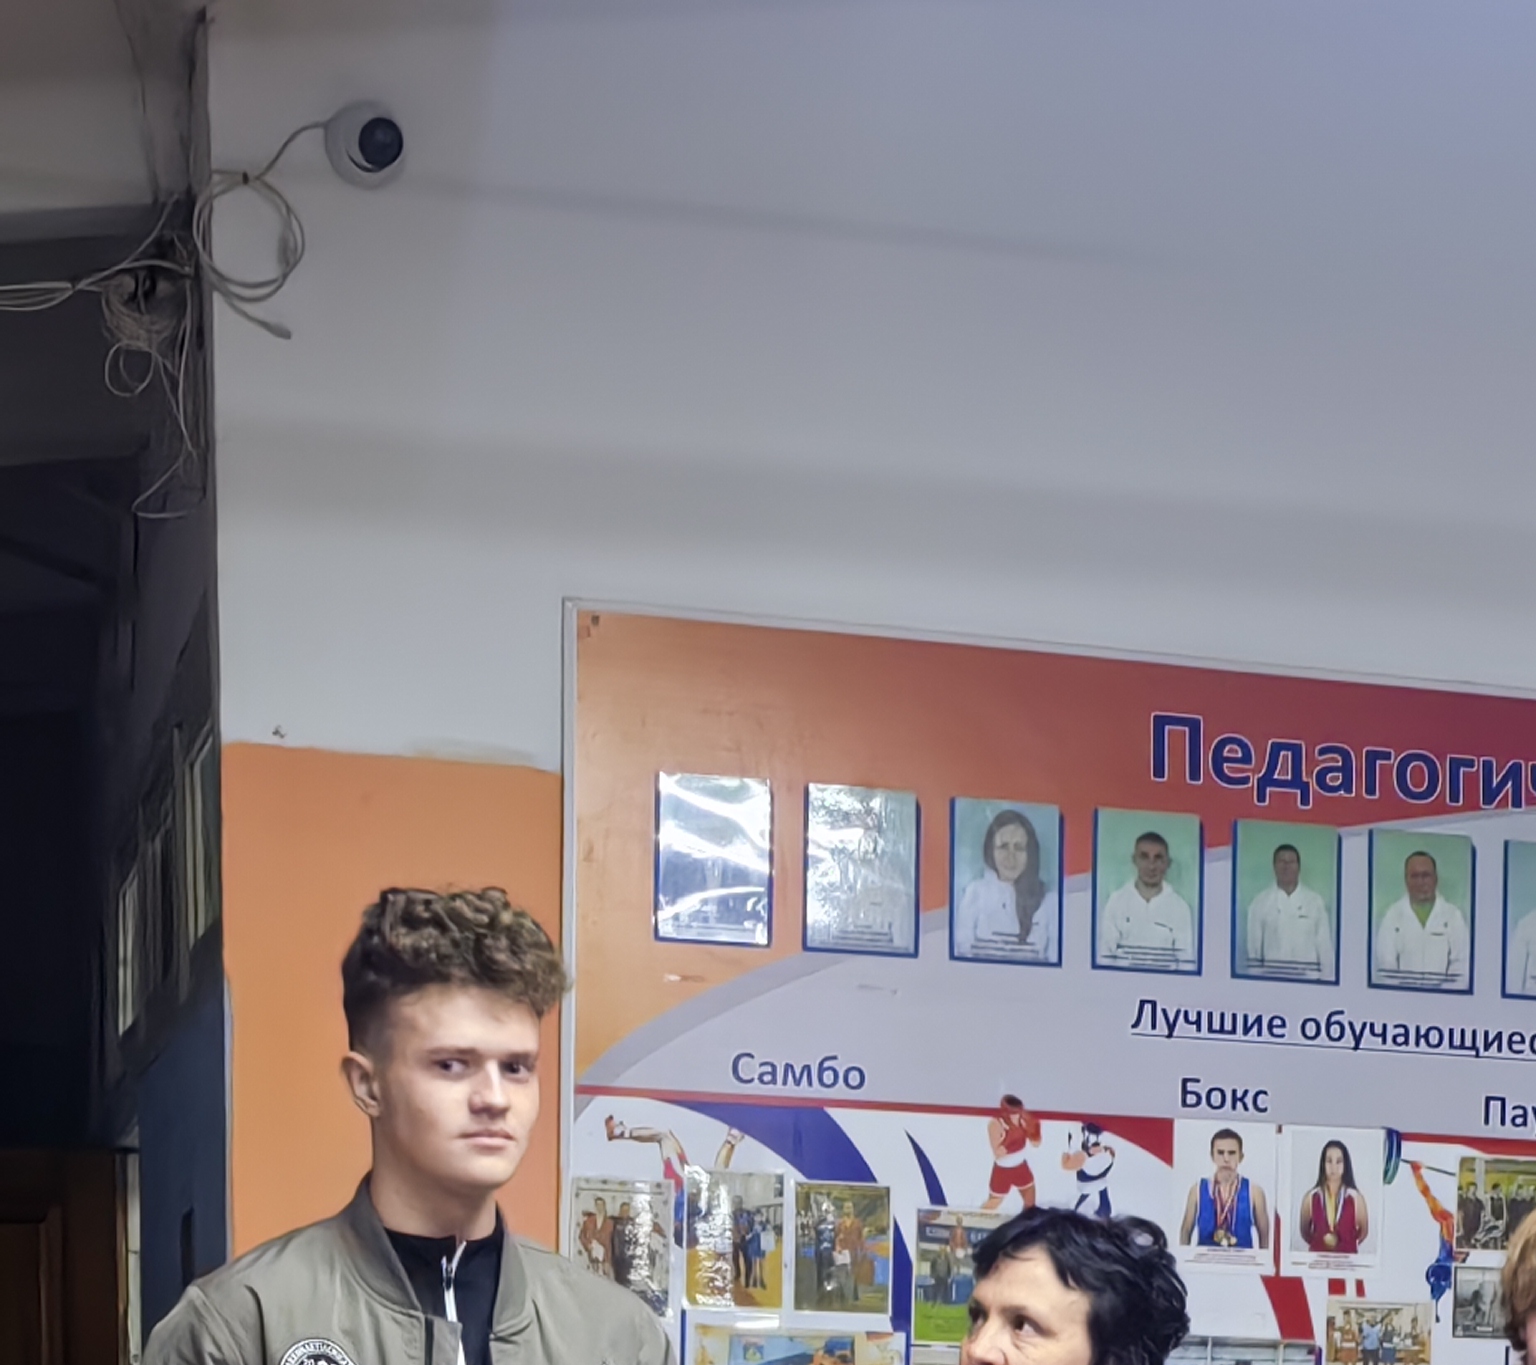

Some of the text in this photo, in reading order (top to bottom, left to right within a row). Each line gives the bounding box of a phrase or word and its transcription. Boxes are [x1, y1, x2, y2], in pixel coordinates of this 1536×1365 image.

[1130, 998, 1287, 1039] Лучшие
[731, 1052, 866, 1091] Самбо
[1180, 1077, 1269, 1113] Бокс
